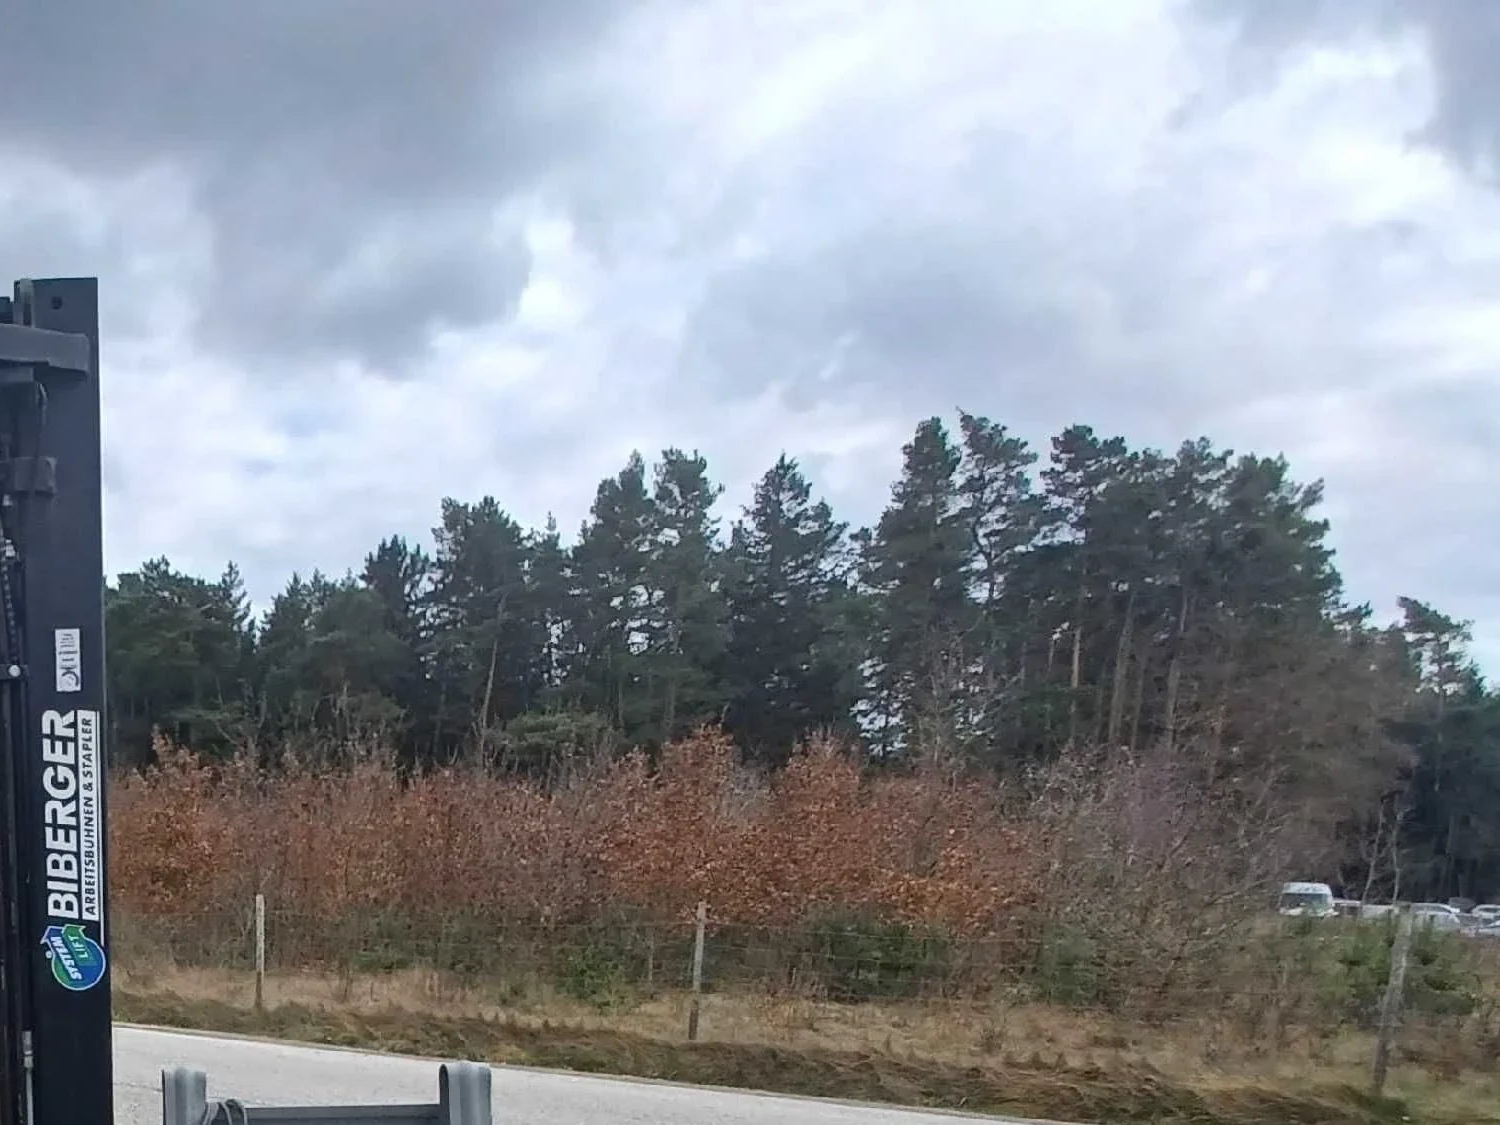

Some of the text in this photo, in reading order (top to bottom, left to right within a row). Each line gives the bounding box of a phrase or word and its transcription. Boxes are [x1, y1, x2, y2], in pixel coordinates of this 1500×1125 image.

[81, 718, 93, 778] STAPLER
[83, 782, 93, 792] &
[41, 709, 79, 919] BIBERGER
[50, 936, 83, 981] SYSTEM
[68, 935, 89, 959] LIFT
